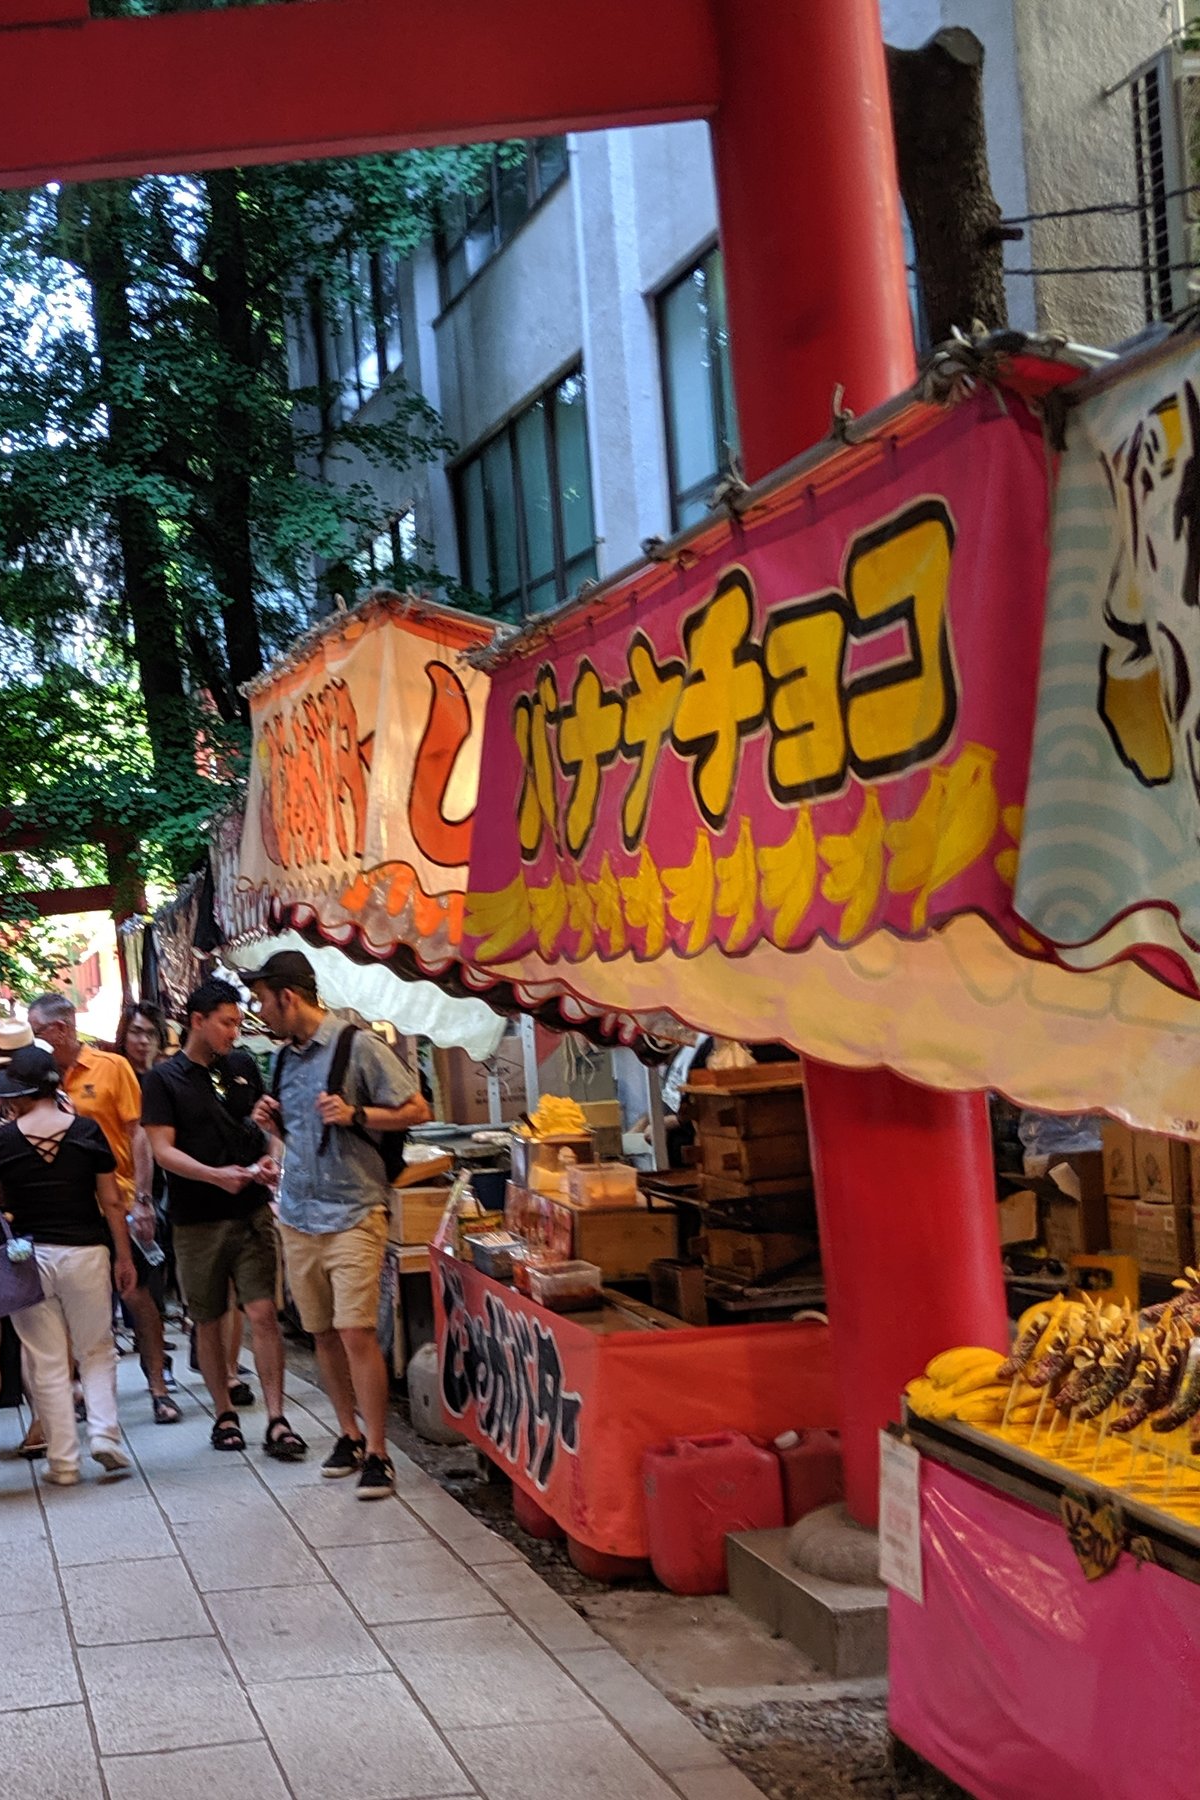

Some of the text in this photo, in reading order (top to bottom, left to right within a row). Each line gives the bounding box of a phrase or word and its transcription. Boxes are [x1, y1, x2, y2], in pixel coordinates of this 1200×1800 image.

[511, 499, 960, 861] バナナチョコ
